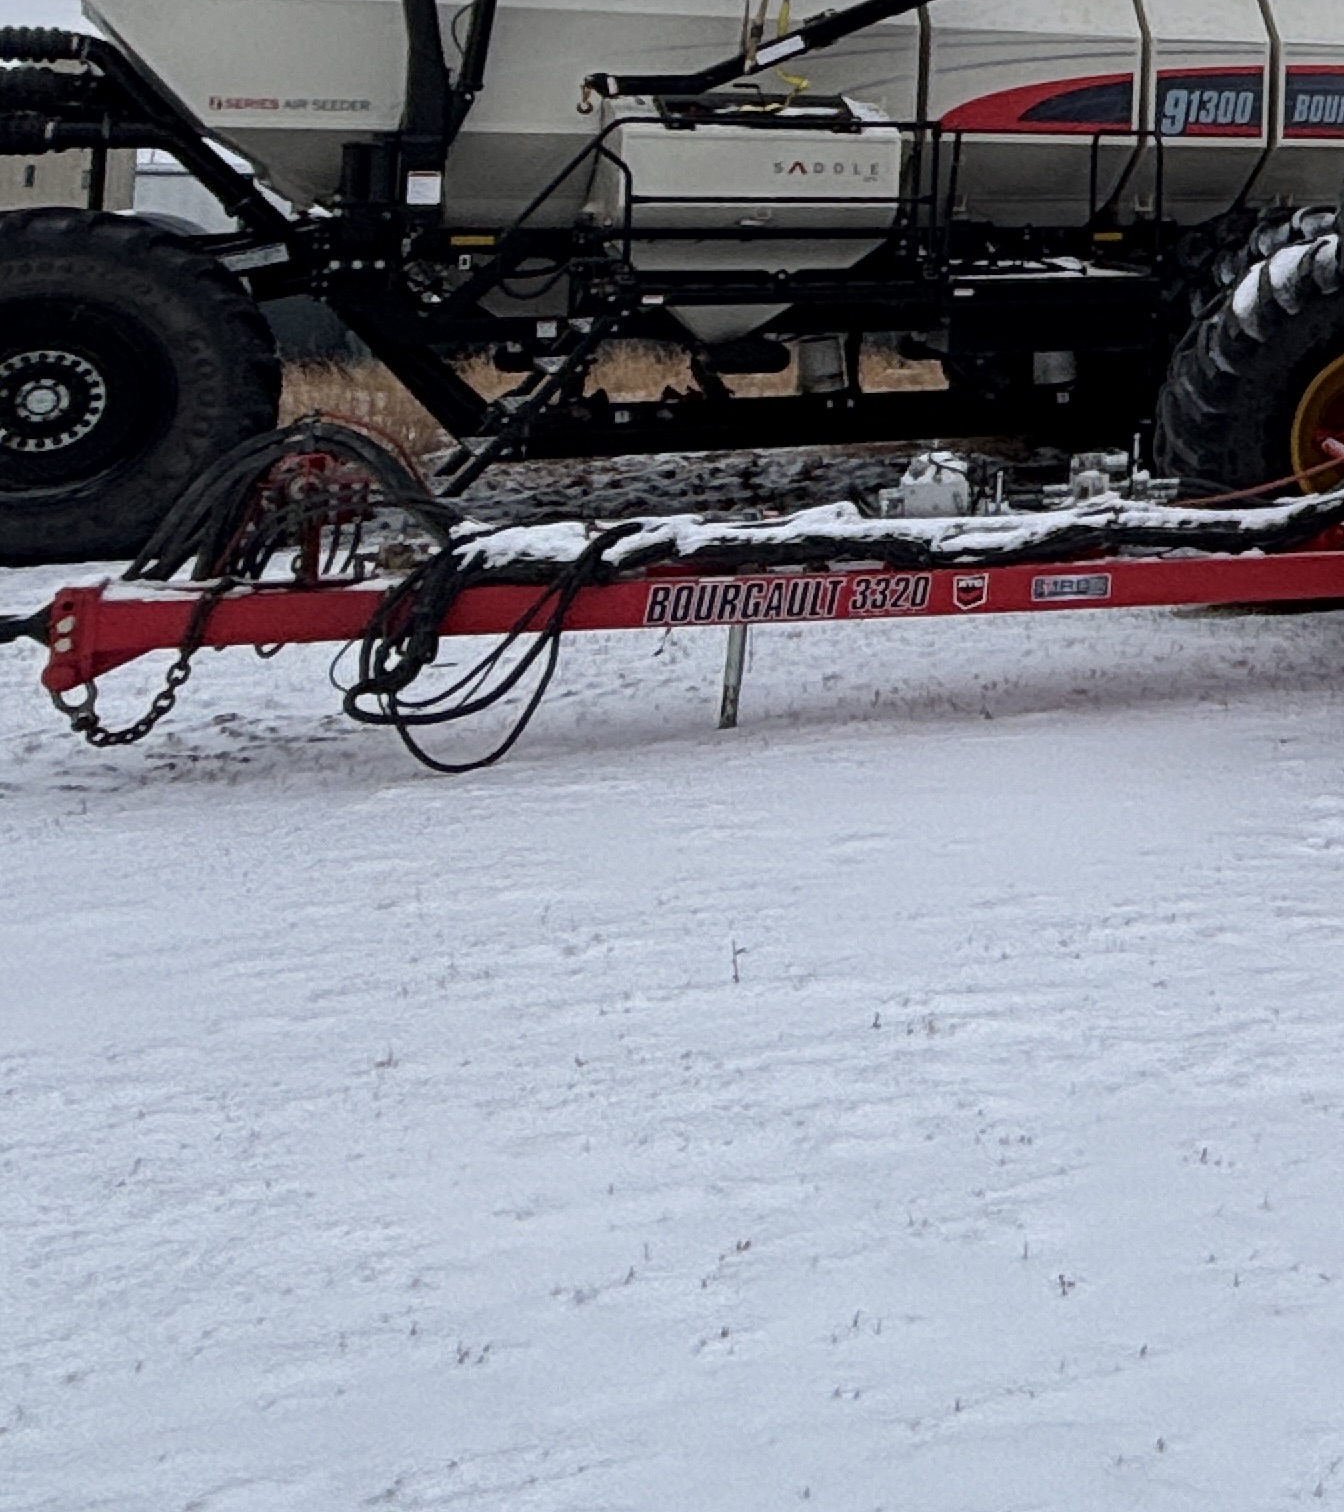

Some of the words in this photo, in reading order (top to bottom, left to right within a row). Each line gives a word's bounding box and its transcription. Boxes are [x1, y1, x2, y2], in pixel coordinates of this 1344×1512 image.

[1161, 89, 1254, 135] 91300
[644, 577, 846, 626] BOURGAULT
[851, 572, 931, 612] 3320
